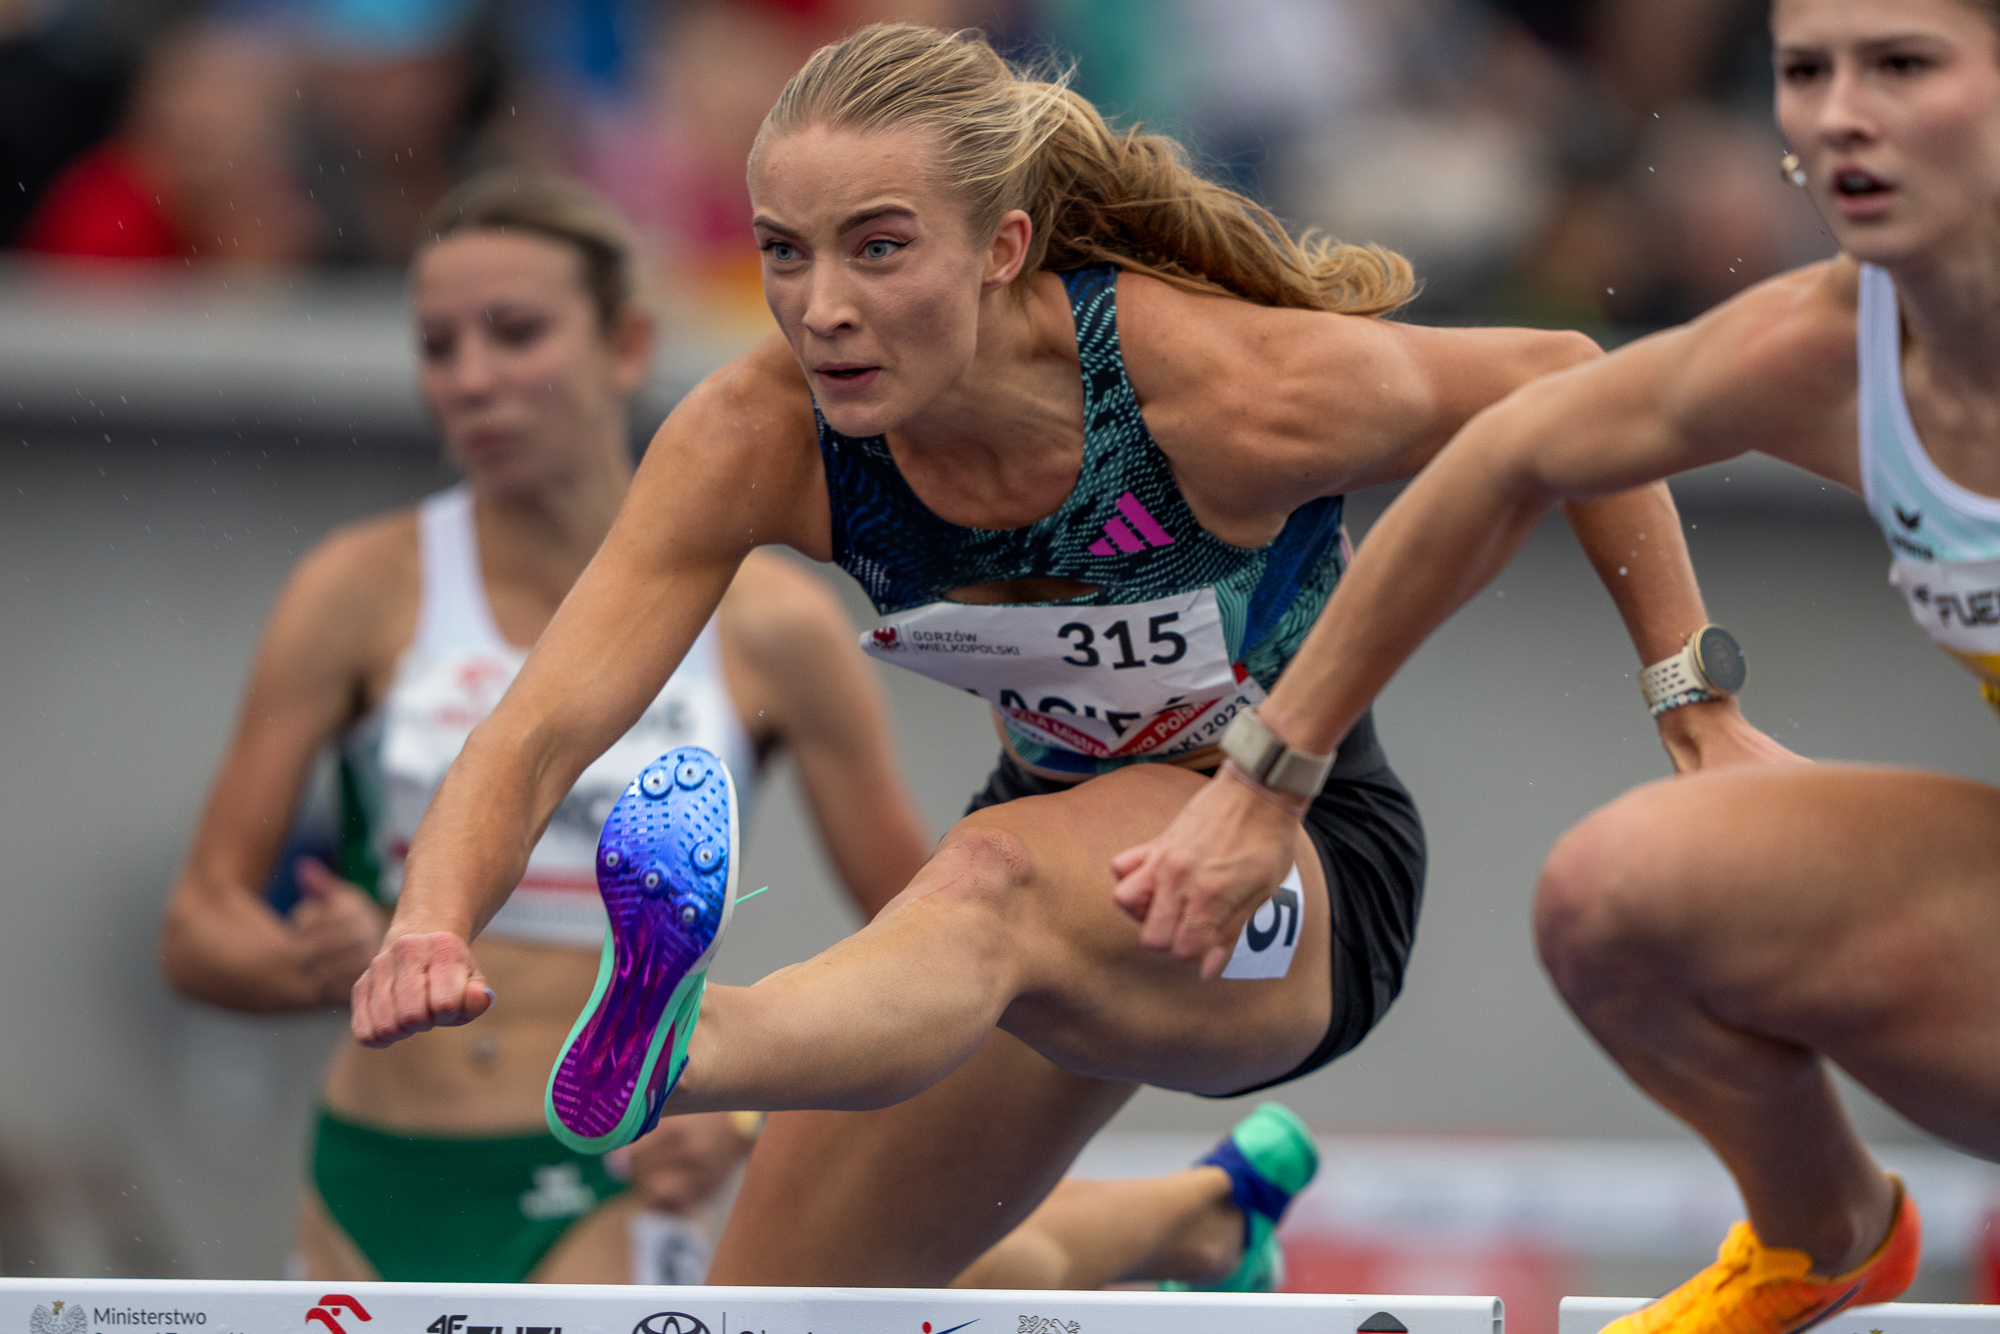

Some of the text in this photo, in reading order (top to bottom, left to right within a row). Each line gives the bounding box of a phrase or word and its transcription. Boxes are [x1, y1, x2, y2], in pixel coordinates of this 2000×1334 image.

[912, 629, 977, 643] GORZÓW
[916, 642, 1021, 656] WIELKOPOLSKI
[1057, 611, 1187, 670] 315
[1202, 695, 1251, 737] 2023
[1246, 886, 1299, 953] 5
[93, 1307, 207, 1326] Ministerstwo
